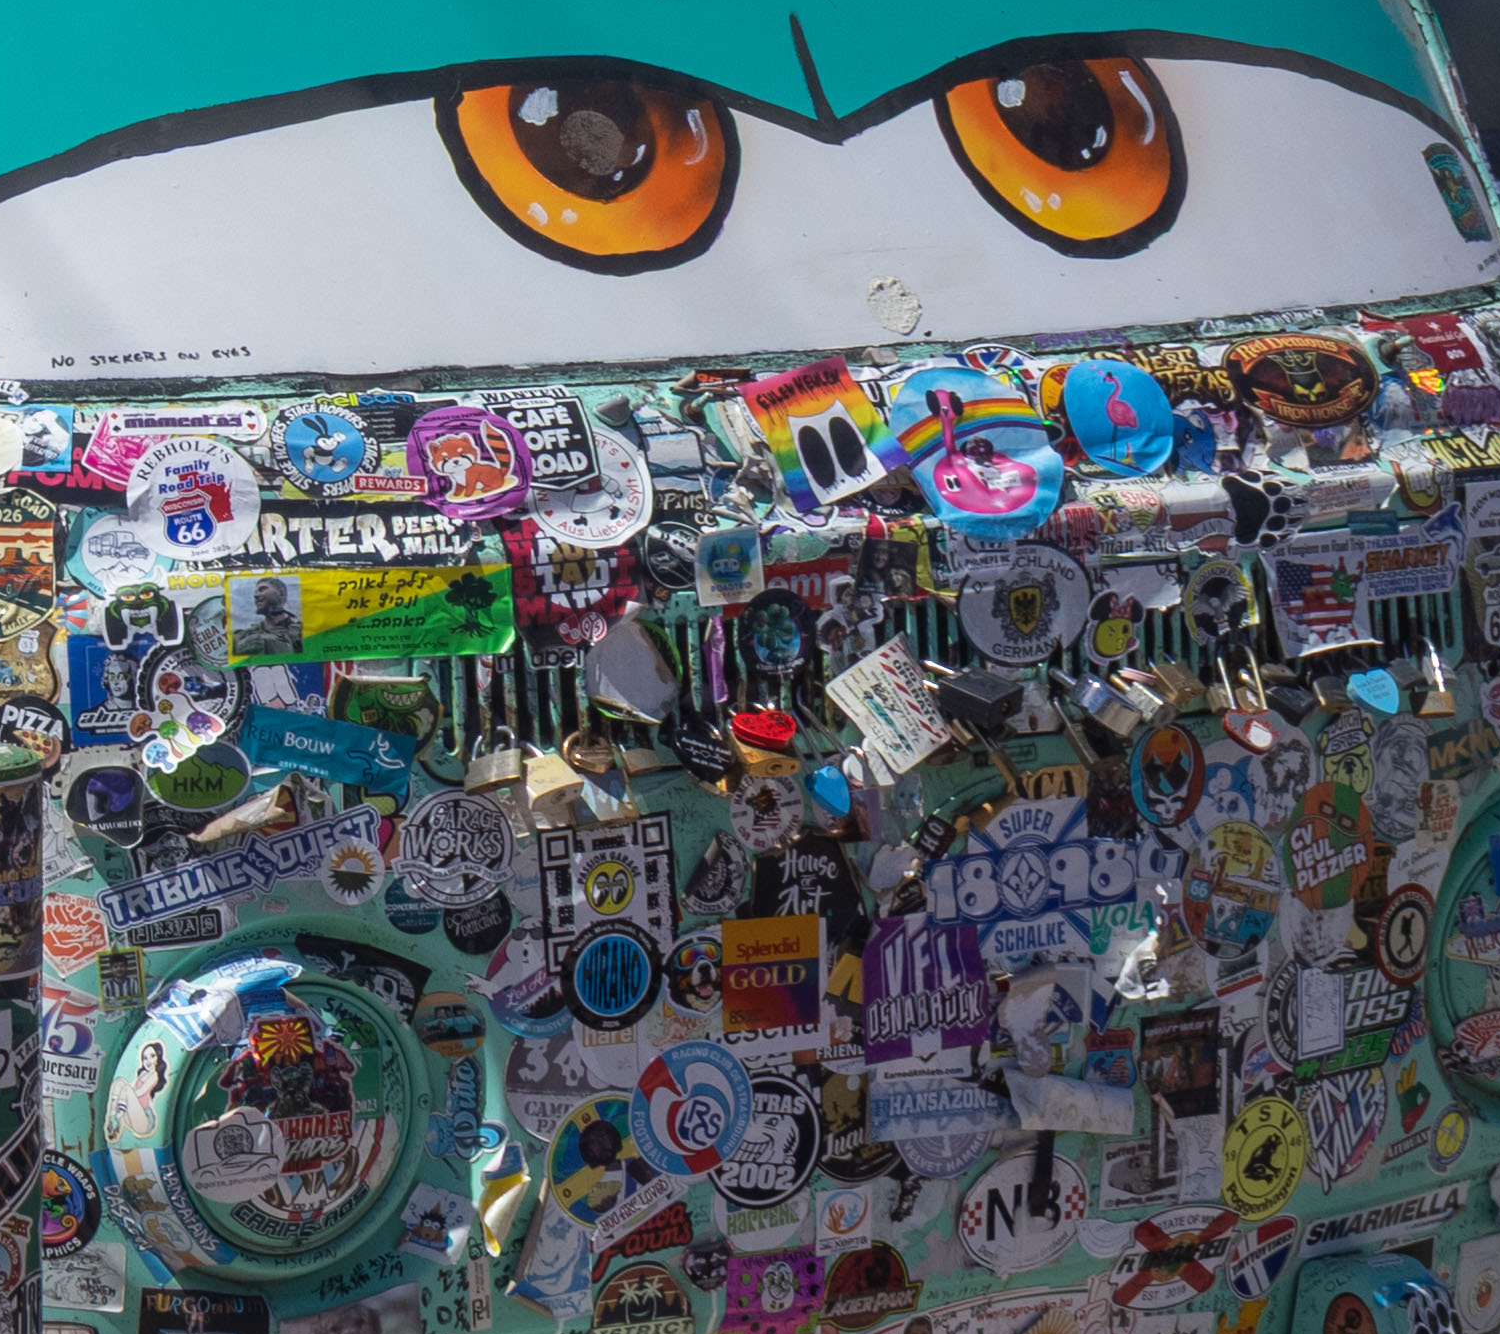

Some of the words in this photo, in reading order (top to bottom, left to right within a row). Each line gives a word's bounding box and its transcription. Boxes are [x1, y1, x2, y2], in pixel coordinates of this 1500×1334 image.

[51, 355, 75, 369] NO
[1239, 339, 1265, 361] Red
[1270, 335, 1337, 355] Demons
[285, 404, 316, 421] STAGE
[318, 403, 365, 429] HOPPERS
[506, 405, 573, 429] CAFÉ
[1277, 400, 1310, 420] IRON
[1313, 400, 1352, 420] HORSE
[137, 437, 234, 483] REBHOLZ'S
[163, 459, 211, 478] Family
[157, 476, 195, 495] Road
[195, 471, 226, 486] Trip
[358, 477, 425, 492] REWARDS
[11, 494, 50, 521] ROAD
[161, 498, 206, 513] WISCONSIN
[173, 513, 204, 526] ROUTE
[556, 521, 585, 536] Aus
[626, 477, 643, 505] Sylt
[177, 524, 207, 544] 66
[403, 534, 470, 555] MALL
[1366, 544, 1451, 570] SHARKEY
[992, 640, 1058, 661] GERMANY
[1, 704, 63, 738] PIZZA
[172, 775, 225, 793] HKM
[429, 802, 501, 831] GARAGE
[1001, 809, 1052, 835] SUPER
[407, 825, 502, 860] WORKS
[1289, 823, 1313, 852] CV
[577, 852, 607, 885] PASSION
[609, 851, 642, 879] GARAGE
[783, 847, 837, 882] House
[1291, 838, 1335, 870] VEUL
[1296, 843, 1368, 892] PLEZIER
[103, 859, 248, 922] TRIBUNE
[271, 816, 377, 870] QUEST
[777, 884, 831, 917] Art
[928, 858, 1000, 922] 18
[735, 937, 801, 961] Splendid
[994, 927, 1067, 953] SCHALKE
[581, 941, 642, 1009] HIRANO
[728, 964, 807, 991] GOLD
[883, 931, 961, 997] VFL
[867, 983, 986, 1042] OSNABRÜCK
[888, 1087, 998, 1116] HANSAZONE
[634, 1109, 671, 1168] FOOTBALL
[66, 1166, 97, 1203] WRAPS
[720, 1162, 796, 1191] 2002
[1225, 1167, 1298, 1219] Poggenhagen
[1306, 1186, 1461, 1247] SMARMELLA
